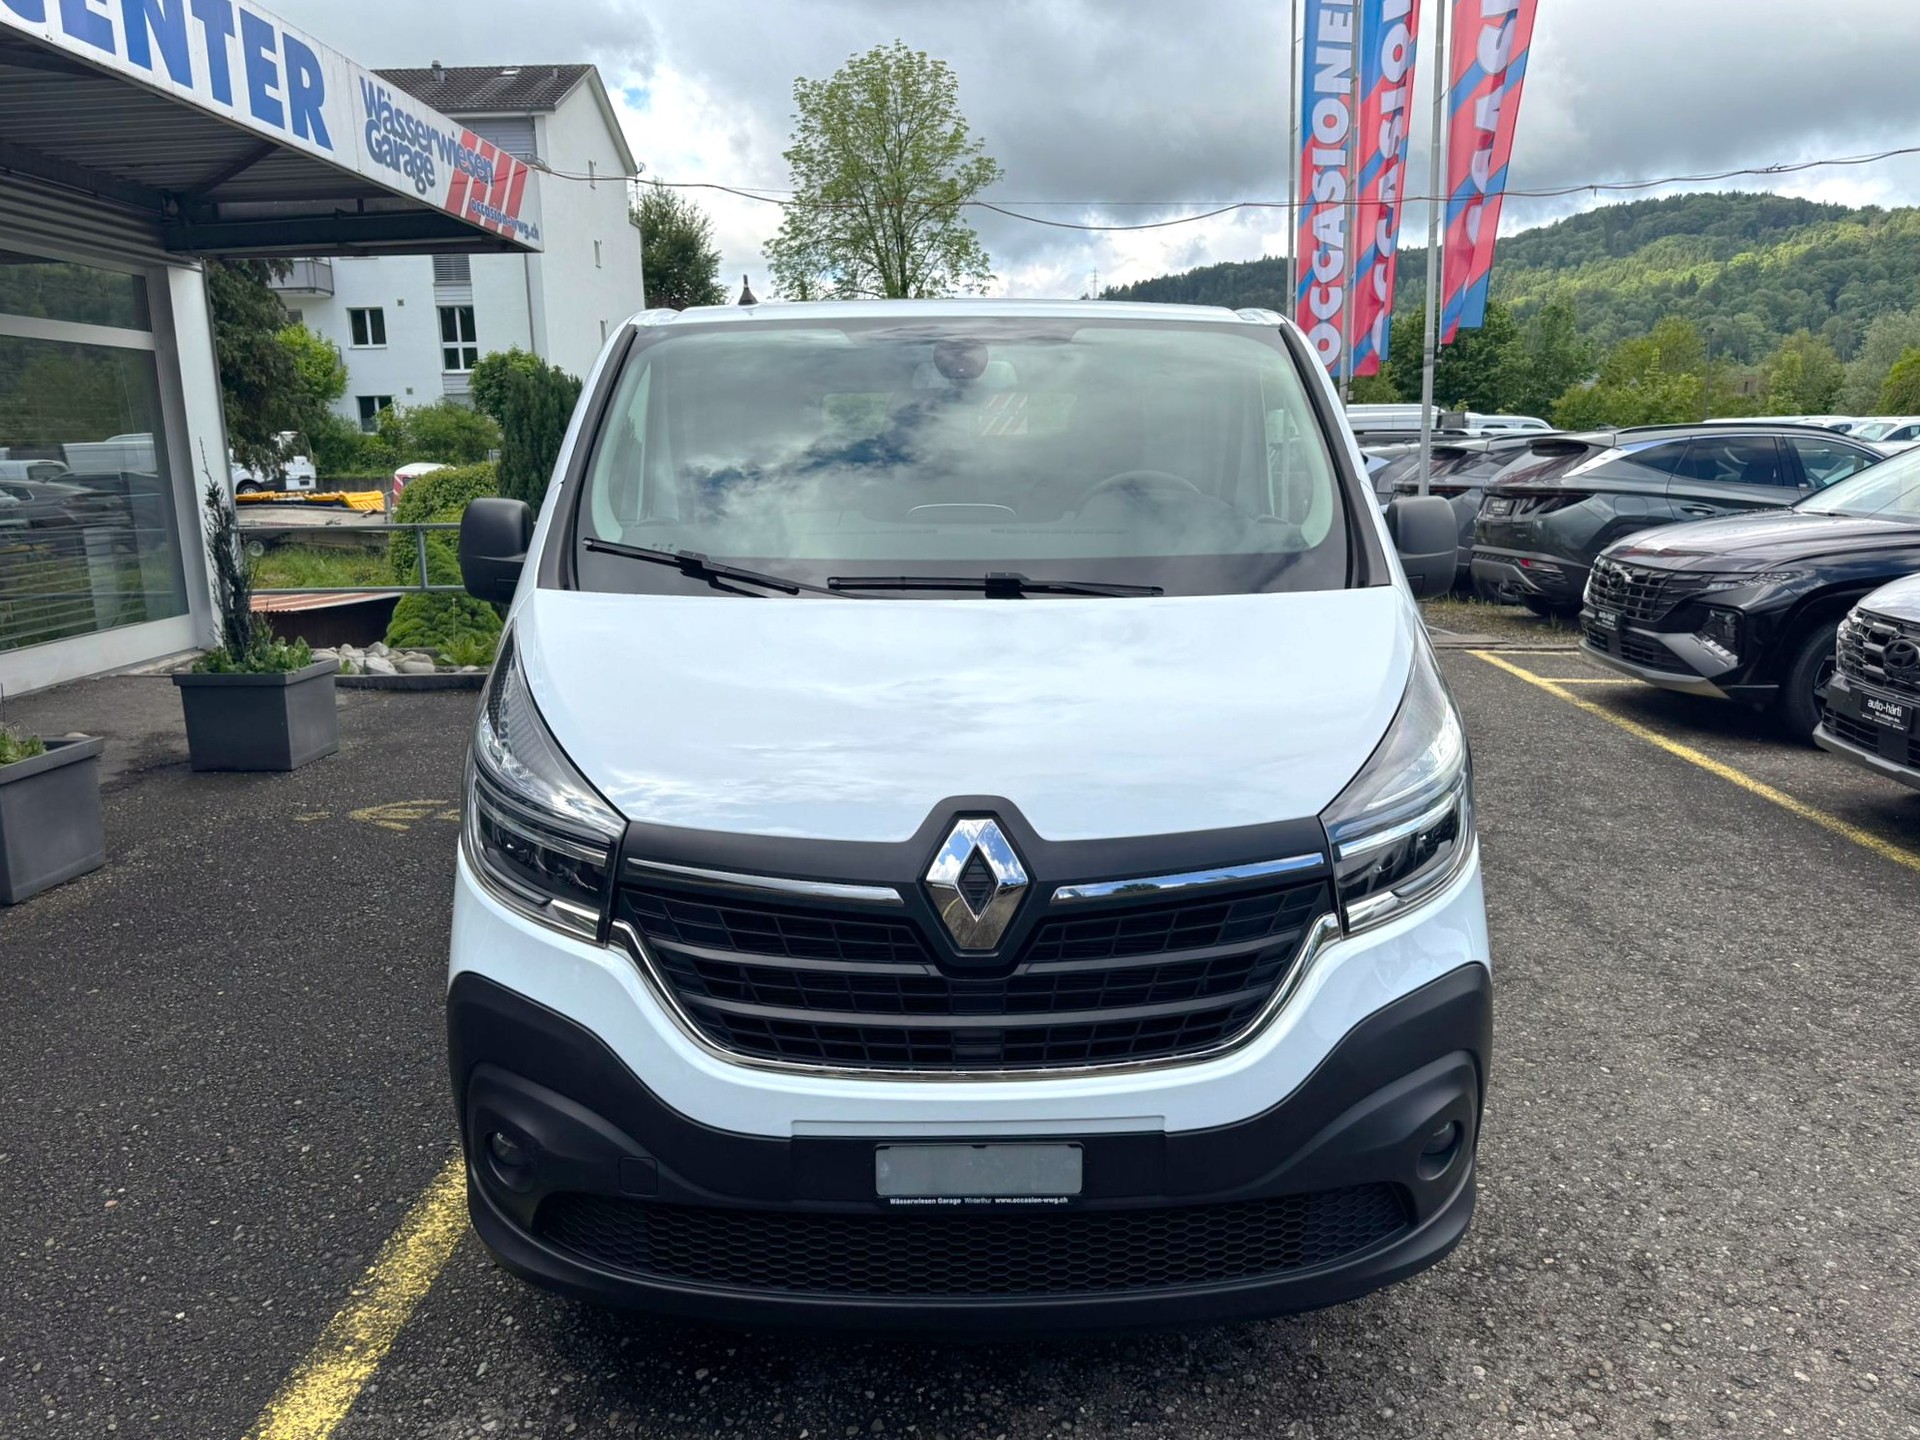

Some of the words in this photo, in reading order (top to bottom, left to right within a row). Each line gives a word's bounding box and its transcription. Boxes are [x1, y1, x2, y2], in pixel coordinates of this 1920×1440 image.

[0, 0, 334, 152] NTER
[359, 75, 495, 188] Wässerwiesen
[365, 118, 436, 196] Garage
[469, 198, 541, 241] occasion-wwg.ch
[1306, 0, 1353, 367] OCCASIONE
[889, 1197, 937, 1205] Wässerwiesen
[937, 1197, 962, 1206] Garage
